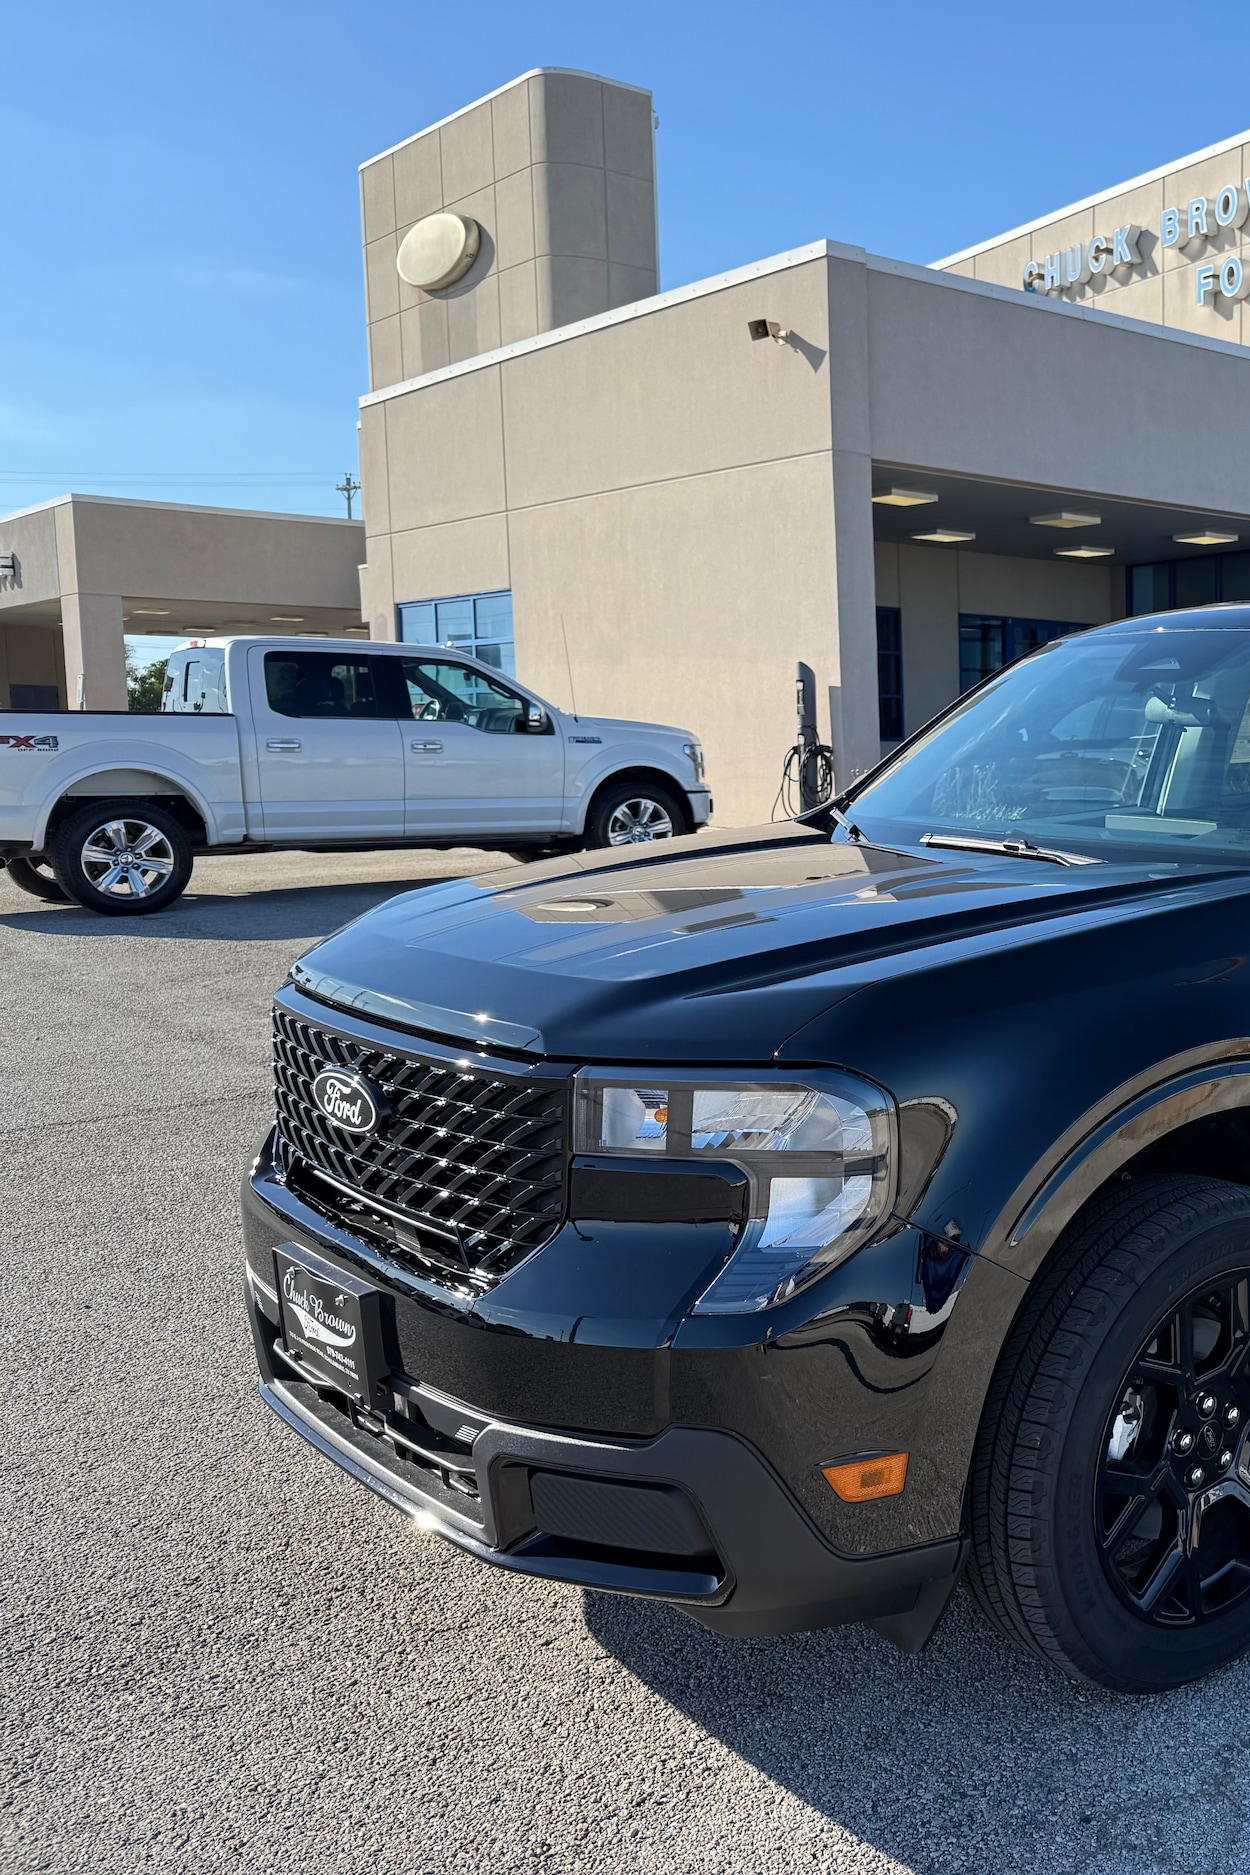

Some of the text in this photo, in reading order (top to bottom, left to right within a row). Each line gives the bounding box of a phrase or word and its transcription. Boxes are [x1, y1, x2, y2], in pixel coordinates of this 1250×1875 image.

[1023, 224, 1134, 293] CHUCK
[324, 1079, 362, 1125] Ford
[283, 1272, 357, 1338] Chuck Brown
[304, 1313, 321, 1339] Ford
